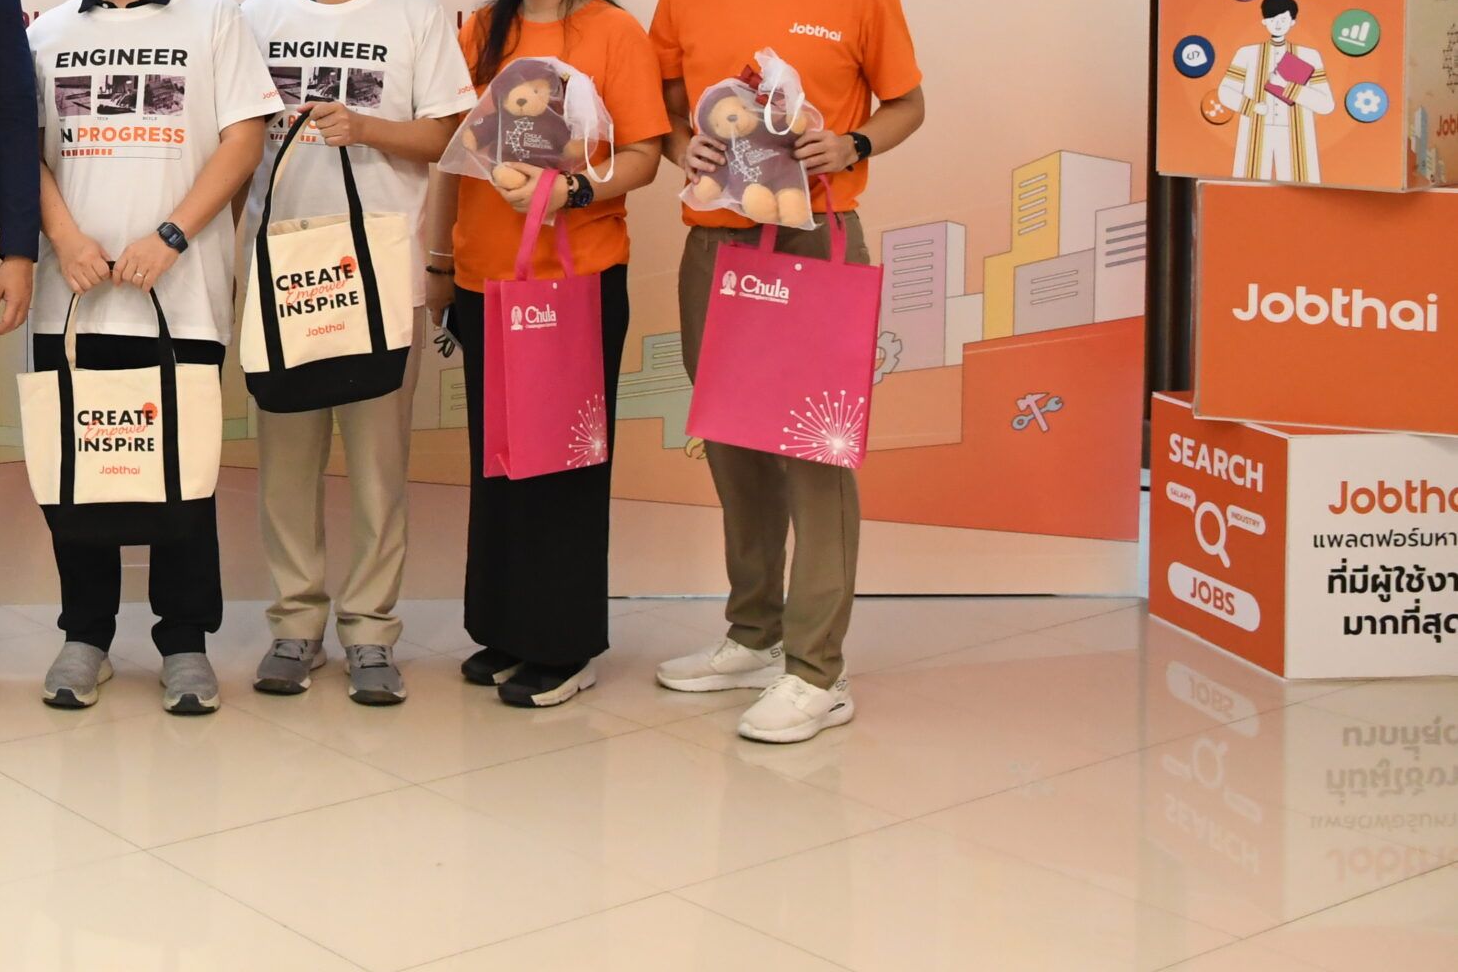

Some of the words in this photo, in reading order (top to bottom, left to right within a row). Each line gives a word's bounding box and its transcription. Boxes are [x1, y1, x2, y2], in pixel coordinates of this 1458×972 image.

[788, 22, 842, 42] Jobthai
[55, 48, 188, 69] ENGINEER
[268, 41, 388, 63] ENGINEER
[76, 126, 186, 144] PROGRESS
[276, 264, 354, 292] CREATE
[740, 274, 790, 299] Chula
[285, 279, 348, 306] Empower
[525, 303, 557, 324] Chula
[1232, 283, 1438, 333] Jobthai
[305, 321, 346, 338] Jobthai
[77, 410, 155, 426] CREATE
[84, 420, 148, 442] Empower
[99, 465, 141, 476] Jobthai
[1168, 433, 1264, 493] SEARCH
[1170, 487, 1192, 501] SALARY
[1230, 511, 1261, 528] INDUSTRY
[1190, 577, 1236, 616] JOBS
